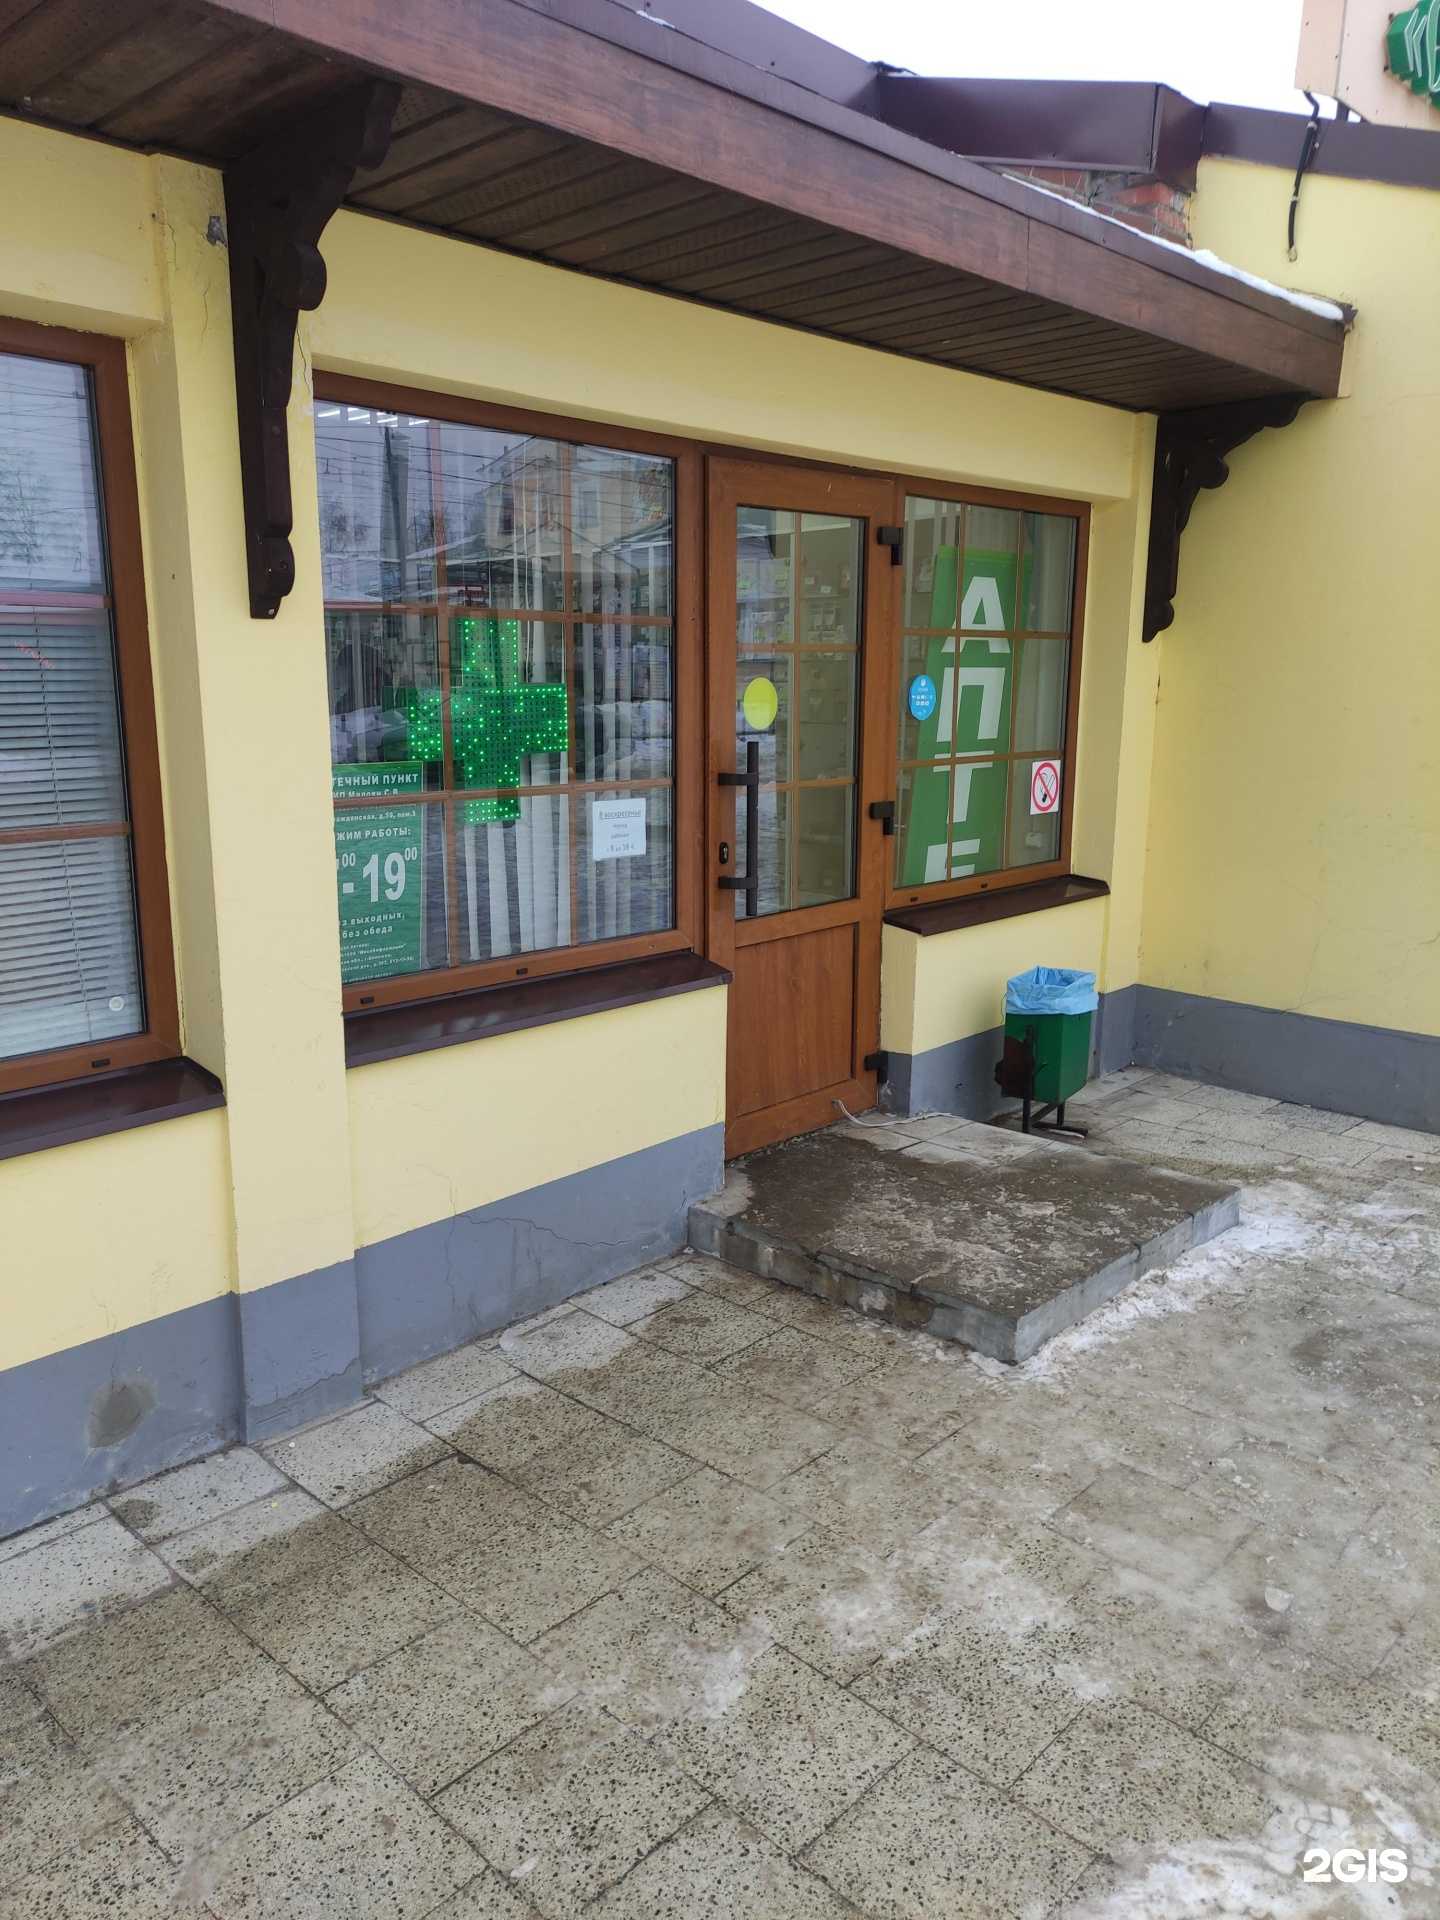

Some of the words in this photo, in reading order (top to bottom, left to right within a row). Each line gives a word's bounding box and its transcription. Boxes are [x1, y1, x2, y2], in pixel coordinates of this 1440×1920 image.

[383, 773, 418, 784] ПУНКТ
[365, 826, 412, 838] РАБОТЫ:
[342, 930, 360, 939] без
[363, 925, 393, 936] обеда
